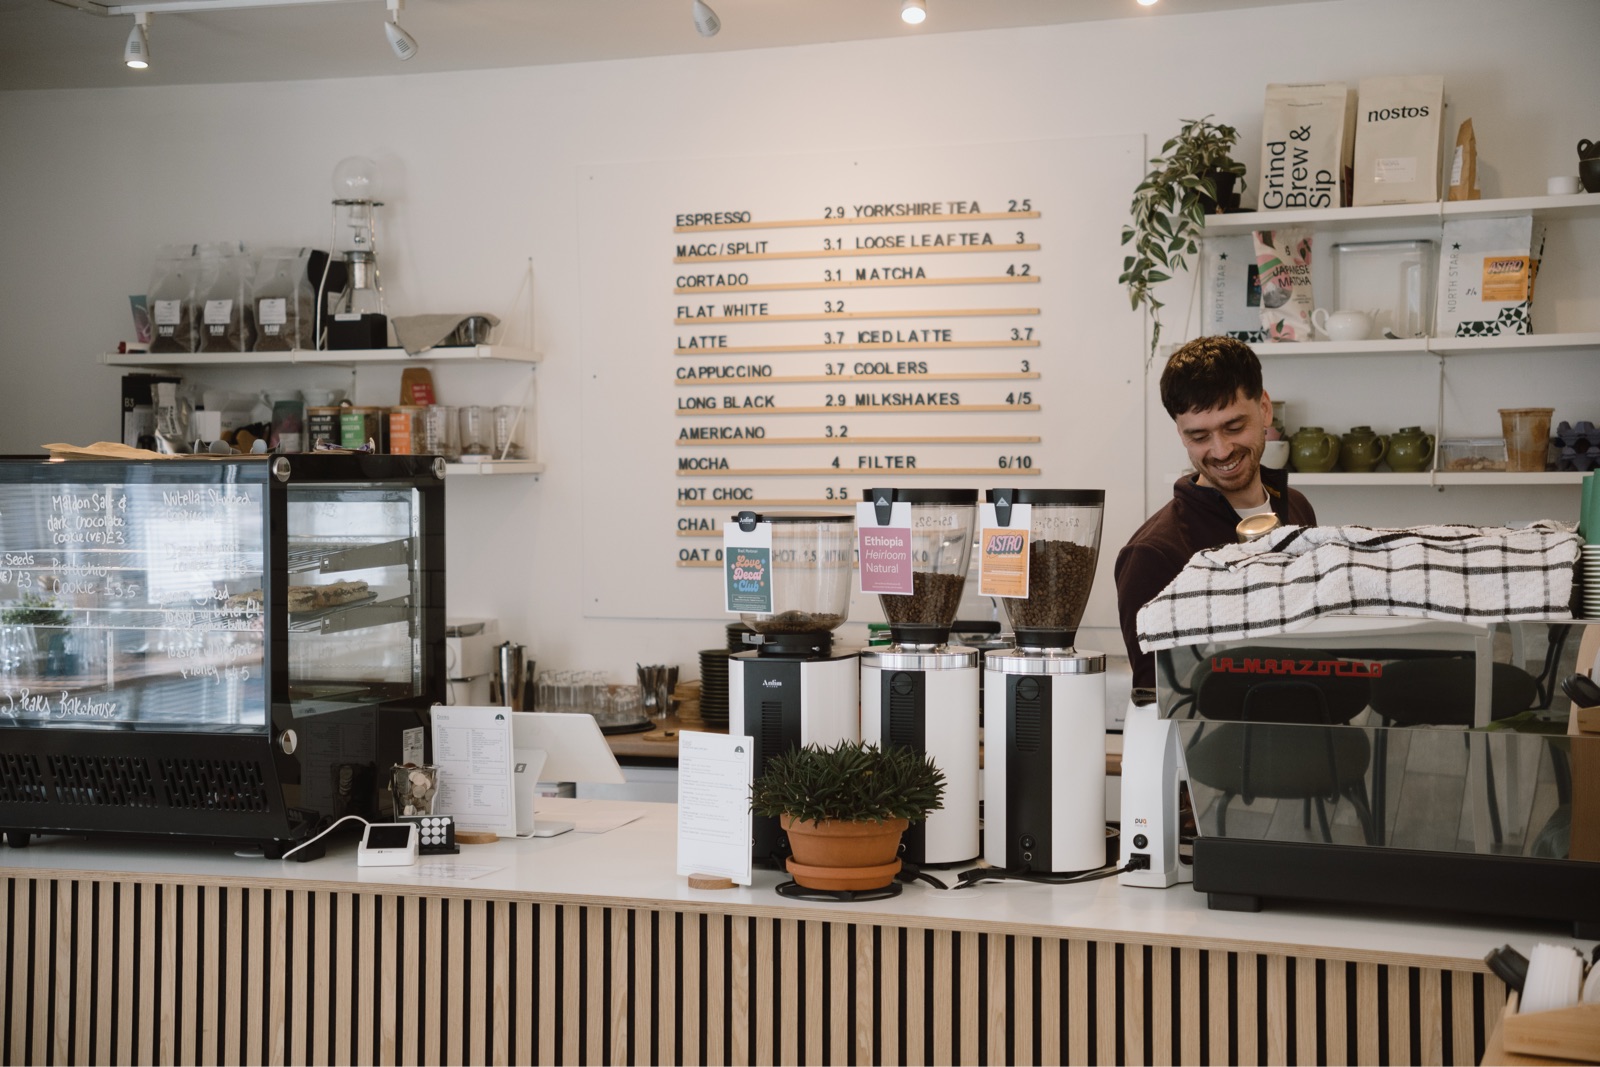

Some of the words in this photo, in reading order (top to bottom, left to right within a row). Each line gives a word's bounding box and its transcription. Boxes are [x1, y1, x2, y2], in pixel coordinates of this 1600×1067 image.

[1367, 105, 1430, 122] nostos
[1289, 125, 1311, 141] &
[1263, 141, 1286, 209] Grind
[1286, 147, 1309, 208] Brew
[1309, 169, 1336, 208] Sip
[675, 211, 751, 226] ESPRESSO
[824, 207, 845, 220] 2.9
[853, 204, 943, 218] YORKSHIRE
[948, 202, 981, 215] TEA
[1008, 199, 1032, 213] 2.5
[823, 238, 843, 252] 3.1
[855, 235, 906, 250] LOOSE
[910, 234, 957, 248] LEAF
[960, 233, 993, 247] TEA
[1016, 232, 1025, 245] 3
[1271, 263, 1311, 277] JAPANESE
[1448, 252, 1460, 277] STAR
[1488, 260, 1525, 275] ASTRO
[676, 273, 749, 288] CORTADO
[824, 270, 843, 283] 3.1
[855, 266, 926, 281] MATCHA
[1006, 264, 1031, 278] 4.2
[1215, 264, 1227, 287] STAR
[1278, 275, 1312, 288] MATCHA
[1447, 279, 1458, 313] NORTH
[677, 305, 715, 319] FLAT
[723, 304, 769, 317] WHITE
[824, 301, 845, 314] 3.2
[1214, 290, 1225, 323] NORTH
[677, 335, 728, 350] LATTE
[824, 332, 845, 346] 3.7
[858, 330, 893, 344] ICED
[896, 329, 952, 343] LATTE
[1010, 327, 1034, 342] 3.7
[676, 365, 773, 380] CAPPUCCINO
[825, 364, 845, 377] 3.7
[854, 361, 929, 376] COOLERS
[1020, 360, 1030, 374] 3
[677, 397, 717, 411] LONG
[723, 395, 775, 409] BLACK
[825, 394, 847, 408] 2.9
[855, 392, 960, 407] MILKSHAKES
[1005, 392, 1032, 407] 4/5
[679, 427, 765, 441] AMERICANO
[825, 426, 848, 439] 3.2
[678, 457, 729, 471] MOCHA
[831, 456, 841, 470] 4
[858, 455, 917, 470] FILTER
[998, 456, 1032, 470] 6/10
[52, 495, 90, 513] Maldon
[92, 493, 114, 511] Salt
[163, 490, 201, 506] Nutella
[677, 488, 707, 502] HOT
[712, 487, 754, 501] CHOC
[825, 487, 848, 501] 3.5
[48, 514, 68, 532] dark
[677, 519, 716, 532] CHAI
[864, 536, 904, 548] Ethiopia
[986, 534, 1024, 555] ASTRO
[679, 548, 711, 562] OAT
[735, 555, 762, 570] Love
[865, 550, 906, 561] Heirloom
[733, 567, 765, 581] Decaf
[865, 563, 899, 574] Natural
[52, 579, 96, 595] Cookie
[738, 580, 759, 592] Club
